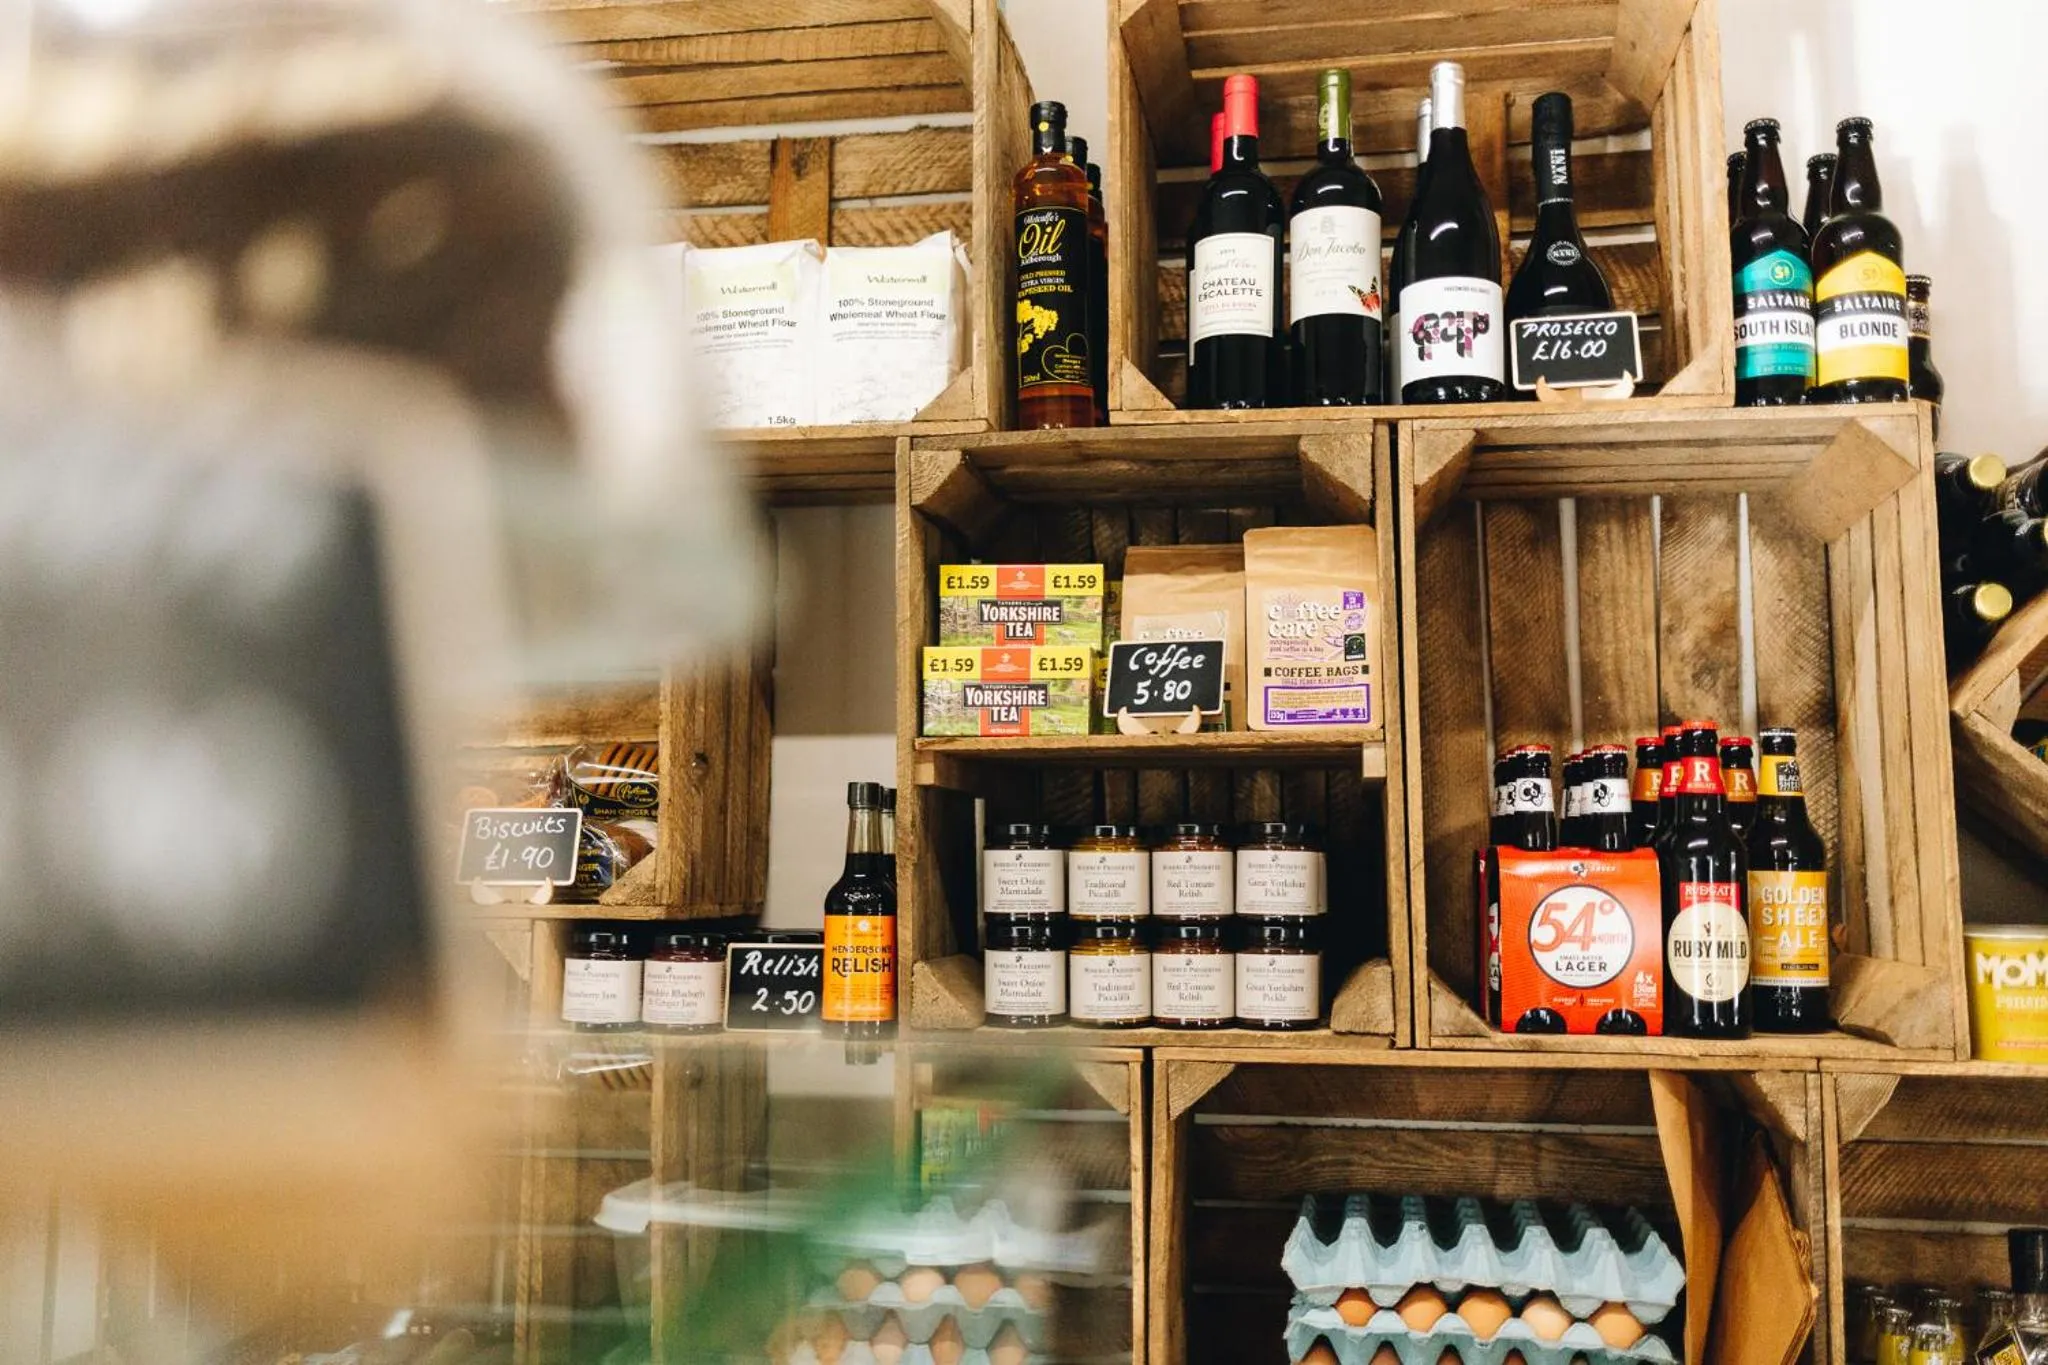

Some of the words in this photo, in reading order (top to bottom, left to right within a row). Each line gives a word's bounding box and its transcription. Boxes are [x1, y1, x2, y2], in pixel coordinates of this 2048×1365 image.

[1019, 219, 1066, 258] Oil
[1057, 285, 1074, 293] OIL
[867, 298, 934, 309] Stoneground
[1747, 293, 1811, 309] SALTAIRE
[1834, 294, 1901, 312] SALTAIRE
[721, 306, 785, 321] Stoneground
[829, 310, 883, 322] Wholemeal
[885, 310, 917, 319] Wheat
[920, 309, 947, 320] Flour
[738, 319, 769, 330] Wheat
[771, 318, 798, 329] Flour
[1521, 321, 1618, 338] PROSECCO
[1839, 321, 1899, 340] BLONDE
[767, 416, 796, 425] 1.5kg
[946, 575, 989, 589] £1.59
[1052, 575, 1097, 589] £1.59
[981, 603, 1060, 621] YORKSHIRE
[1006, 622, 1033, 636] TEA
[929, 658, 974, 672] £1.59
[1038, 657, 1084, 671] £1.59
[1129, 644, 1207, 679] Coffee
[1274, 667, 1321, 678] COFFEE
[1326, 665, 1360, 677] BAGS
[965, 687, 1046, 705] YORKSHIRE
[992, 707, 1018, 722] TEA
[1694, 761, 1711, 782] R
[1734, 772, 1750, 790] R
[475, 816, 567, 840] Biscuits
[485, 842, 554, 871] £1.90
[1779, 930, 1819, 949] ALE
[1674, 940, 1712, 958] RUBY
[1716, 940, 1747, 959] MILD
[740, 950, 819, 978] Relish
[831, 957, 891, 978] RELISH
[1555, 961, 1608, 972] LAGER
